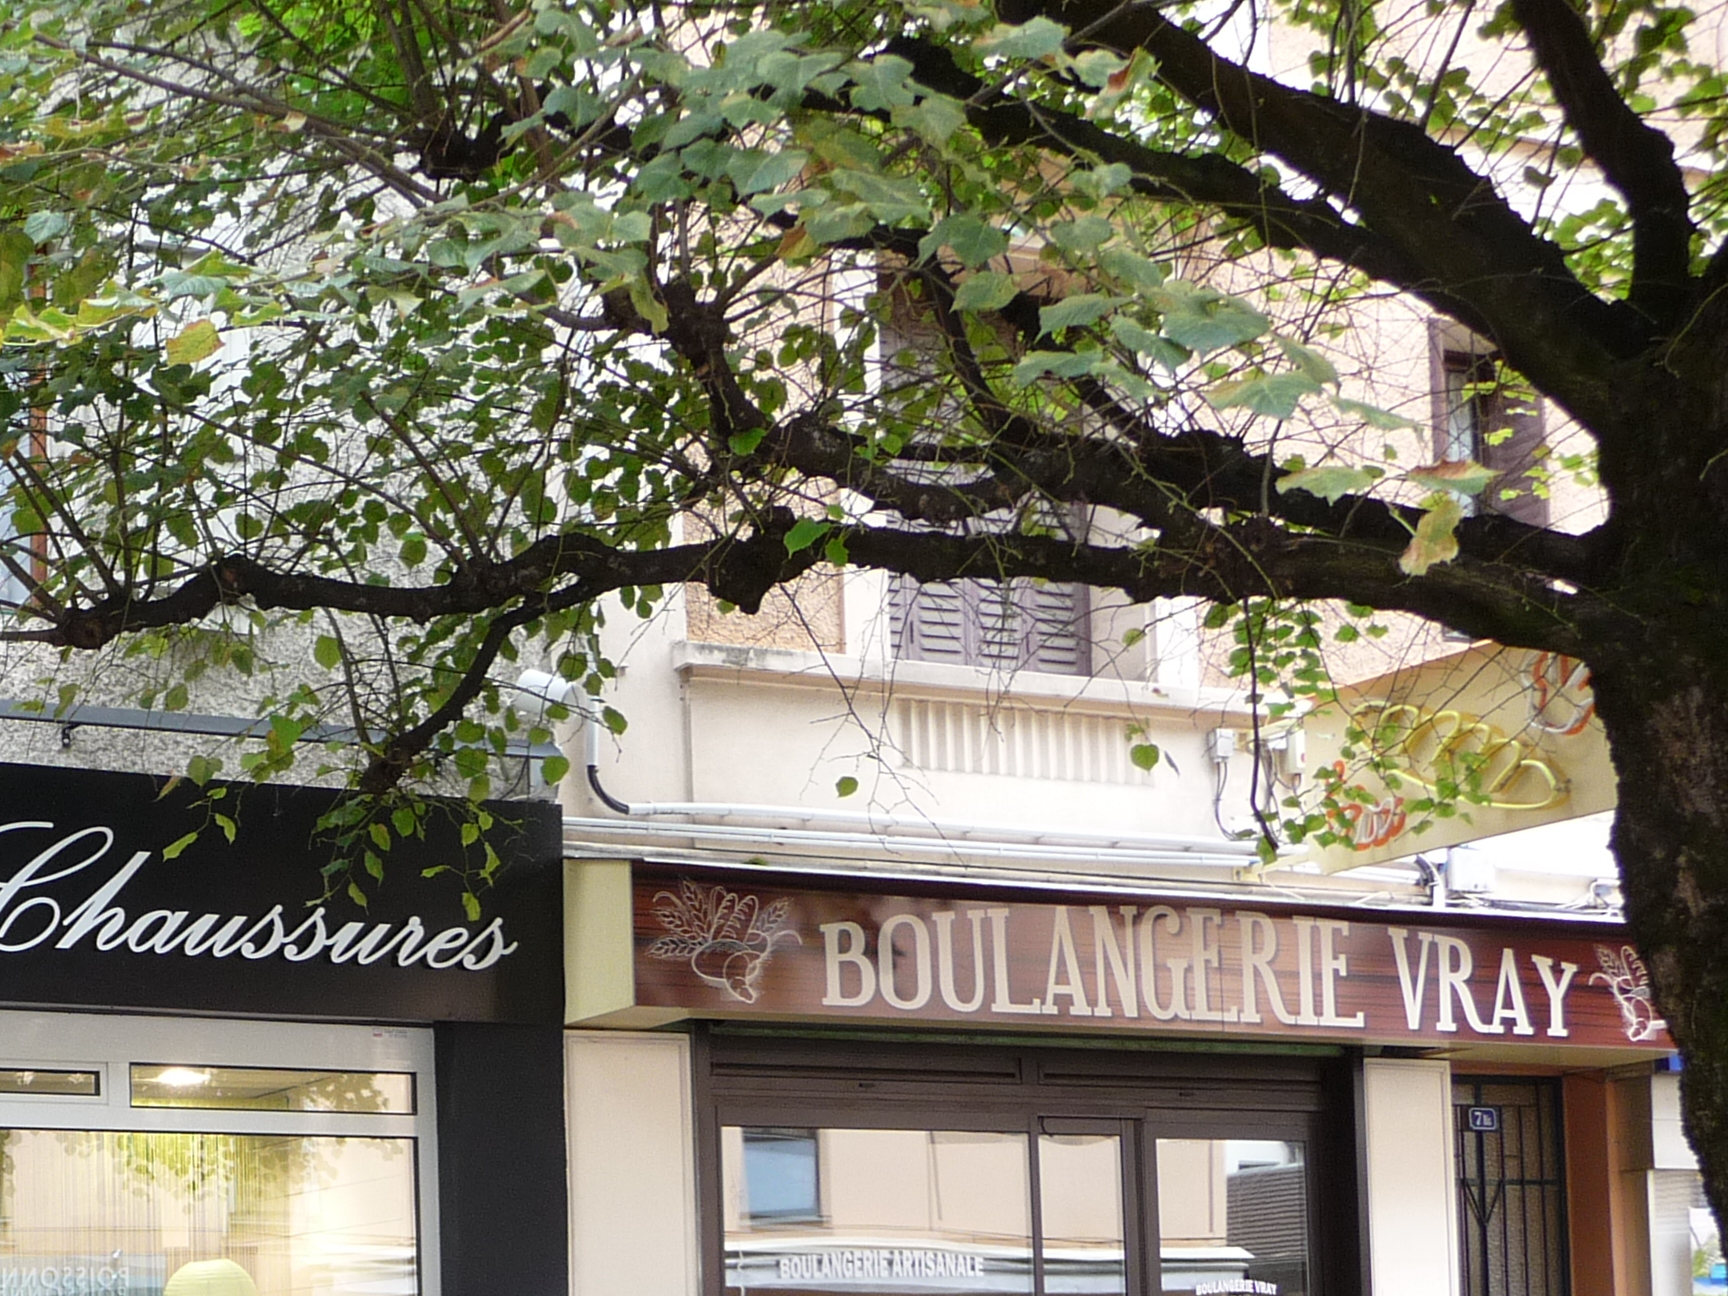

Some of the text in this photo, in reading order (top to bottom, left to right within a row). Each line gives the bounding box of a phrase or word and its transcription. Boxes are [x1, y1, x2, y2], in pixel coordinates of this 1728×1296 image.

[819, 904, 1579, 1038] BOULANGERIE VRAY
[779, 1250, 985, 1279] BOULANGERIE ARTISANALE
